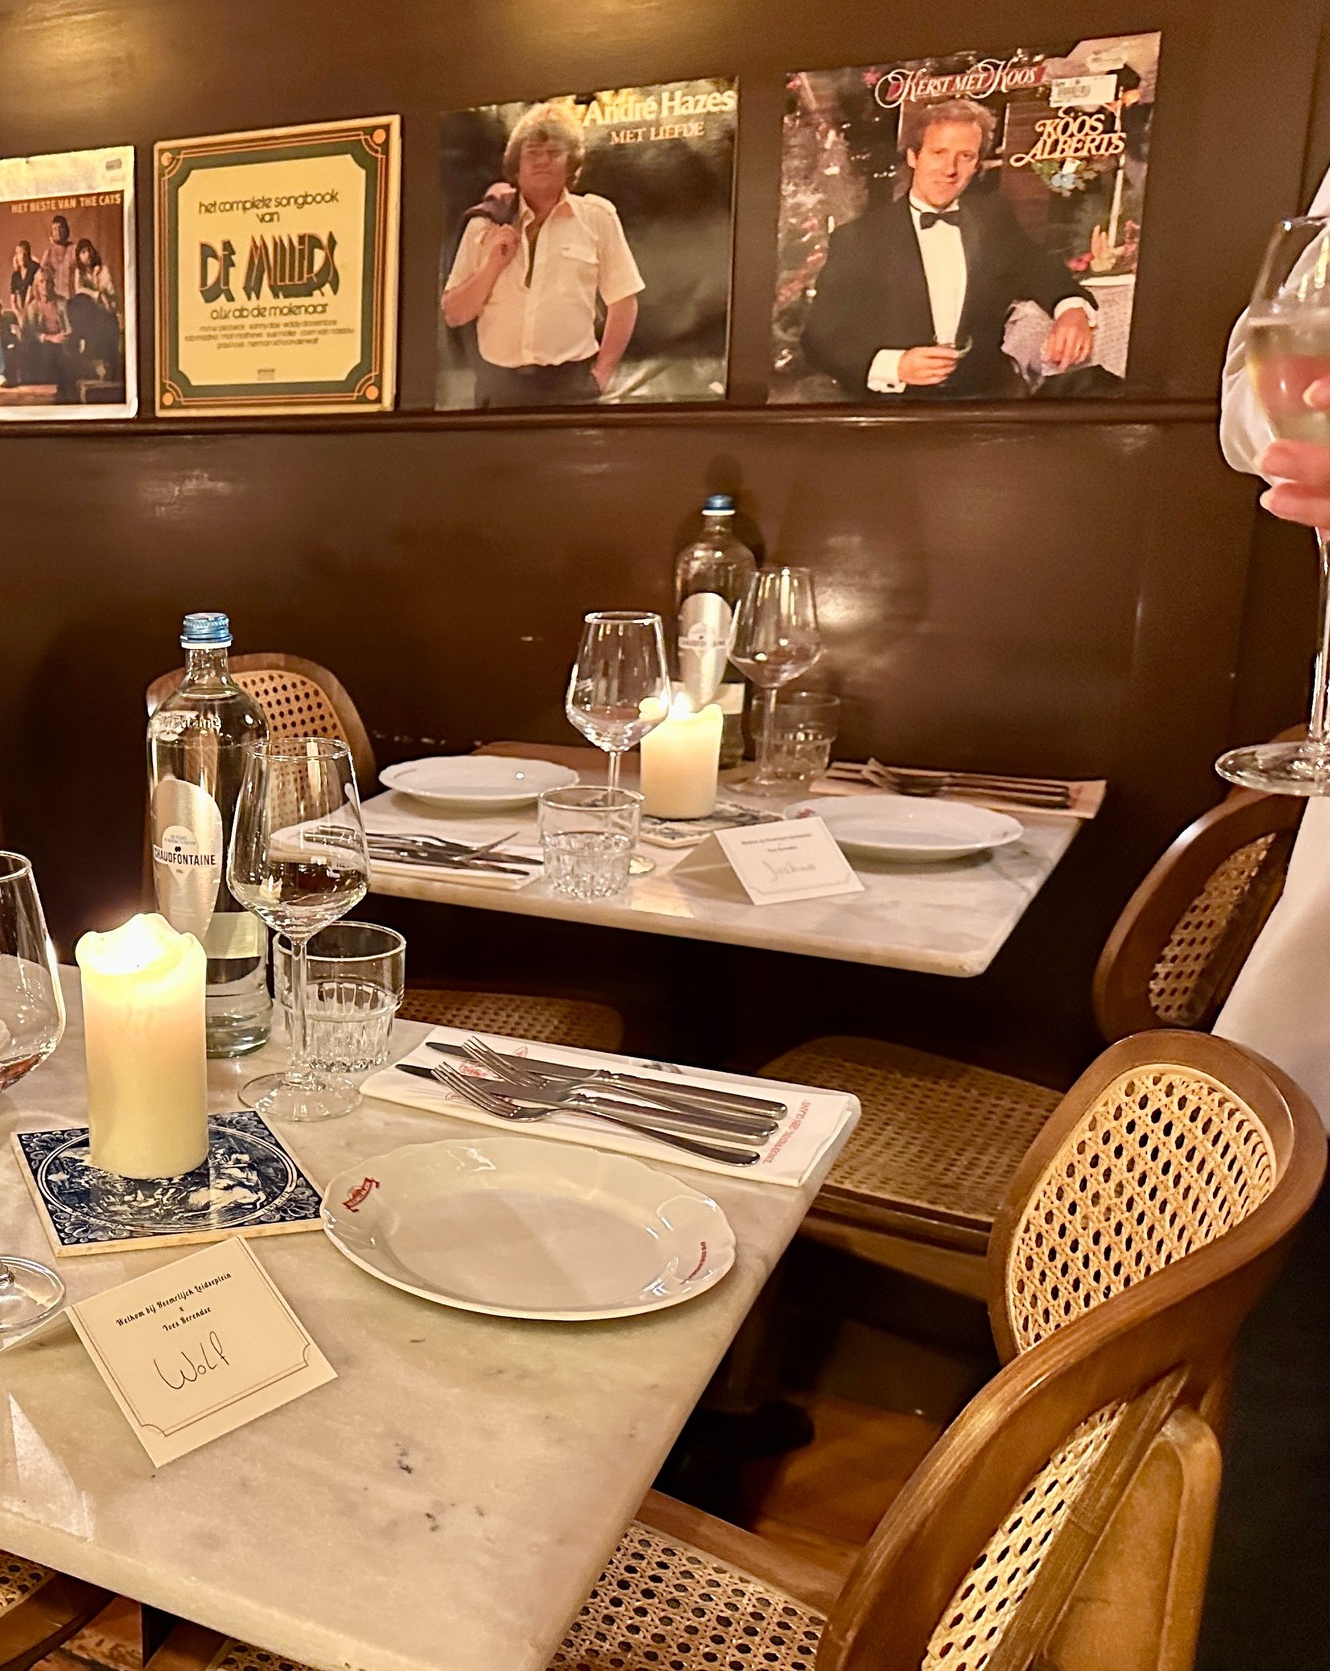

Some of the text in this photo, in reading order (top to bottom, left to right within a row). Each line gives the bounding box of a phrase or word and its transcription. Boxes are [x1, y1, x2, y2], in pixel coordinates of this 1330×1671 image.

[874, 68, 954, 108] KERST
[952, 72, 988, 94] MET
[966, 57, 1038, 99] KOOS
[583, 89, 737, 127] André Hazes
[610, 121, 705, 145] MET LIEFDE
[1034, 106, 1106, 141] KOOS
[1009, 132, 1127, 167] ALBERTS
[11, 193, 121, 213] HET BESTE VAN THE CATS
[198, 189, 339, 215] het complete songbook
[256, 211, 280, 223] van
[199, 239, 236, 304] DE
[268, 303, 329, 317] molenaar
[115, 1310, 145, 1327] Welkom
[145, 1303, 157, 1314] bij
[194, 1272, 232, 1293] Leidseplein
[179, 1306, 212, 1324] Berendse
